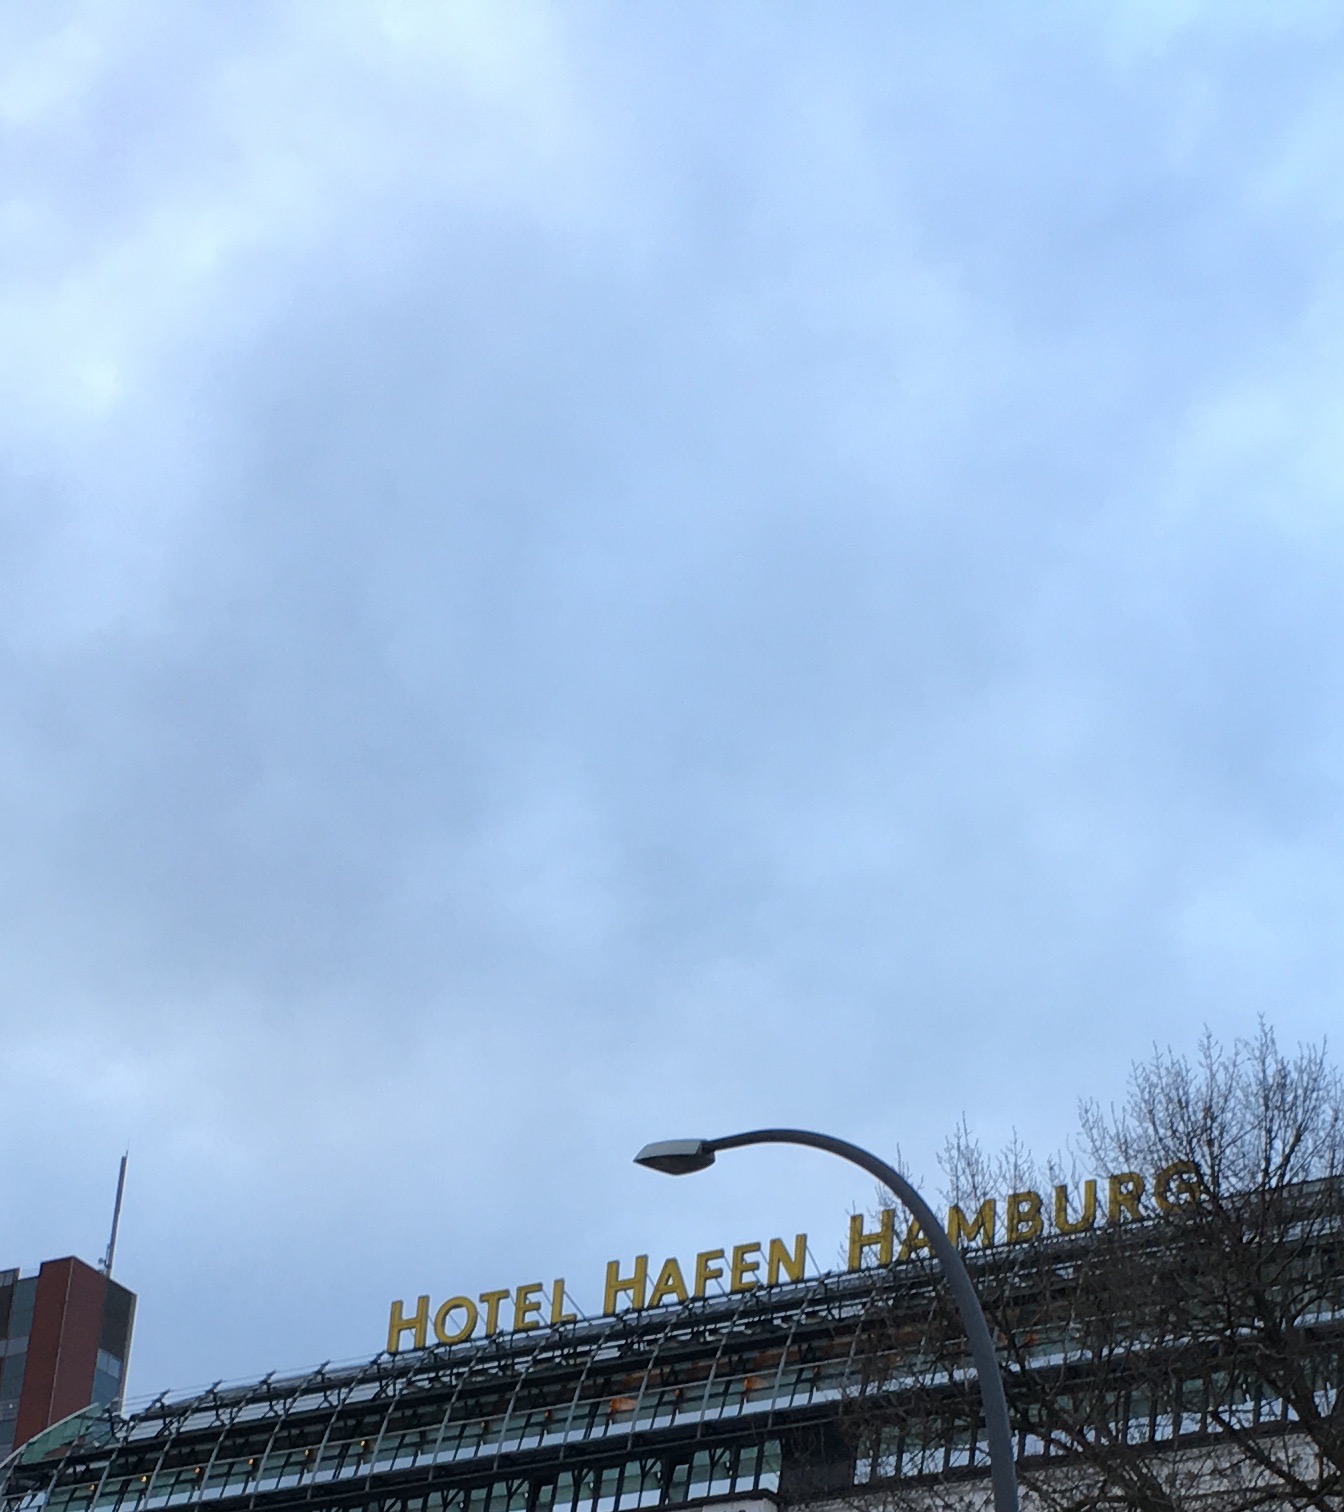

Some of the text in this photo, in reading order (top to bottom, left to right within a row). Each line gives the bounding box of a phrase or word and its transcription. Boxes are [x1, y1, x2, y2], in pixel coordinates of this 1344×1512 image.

[387, 1158, 1206, 1353] HOTEL HAFEN HAMBURG
